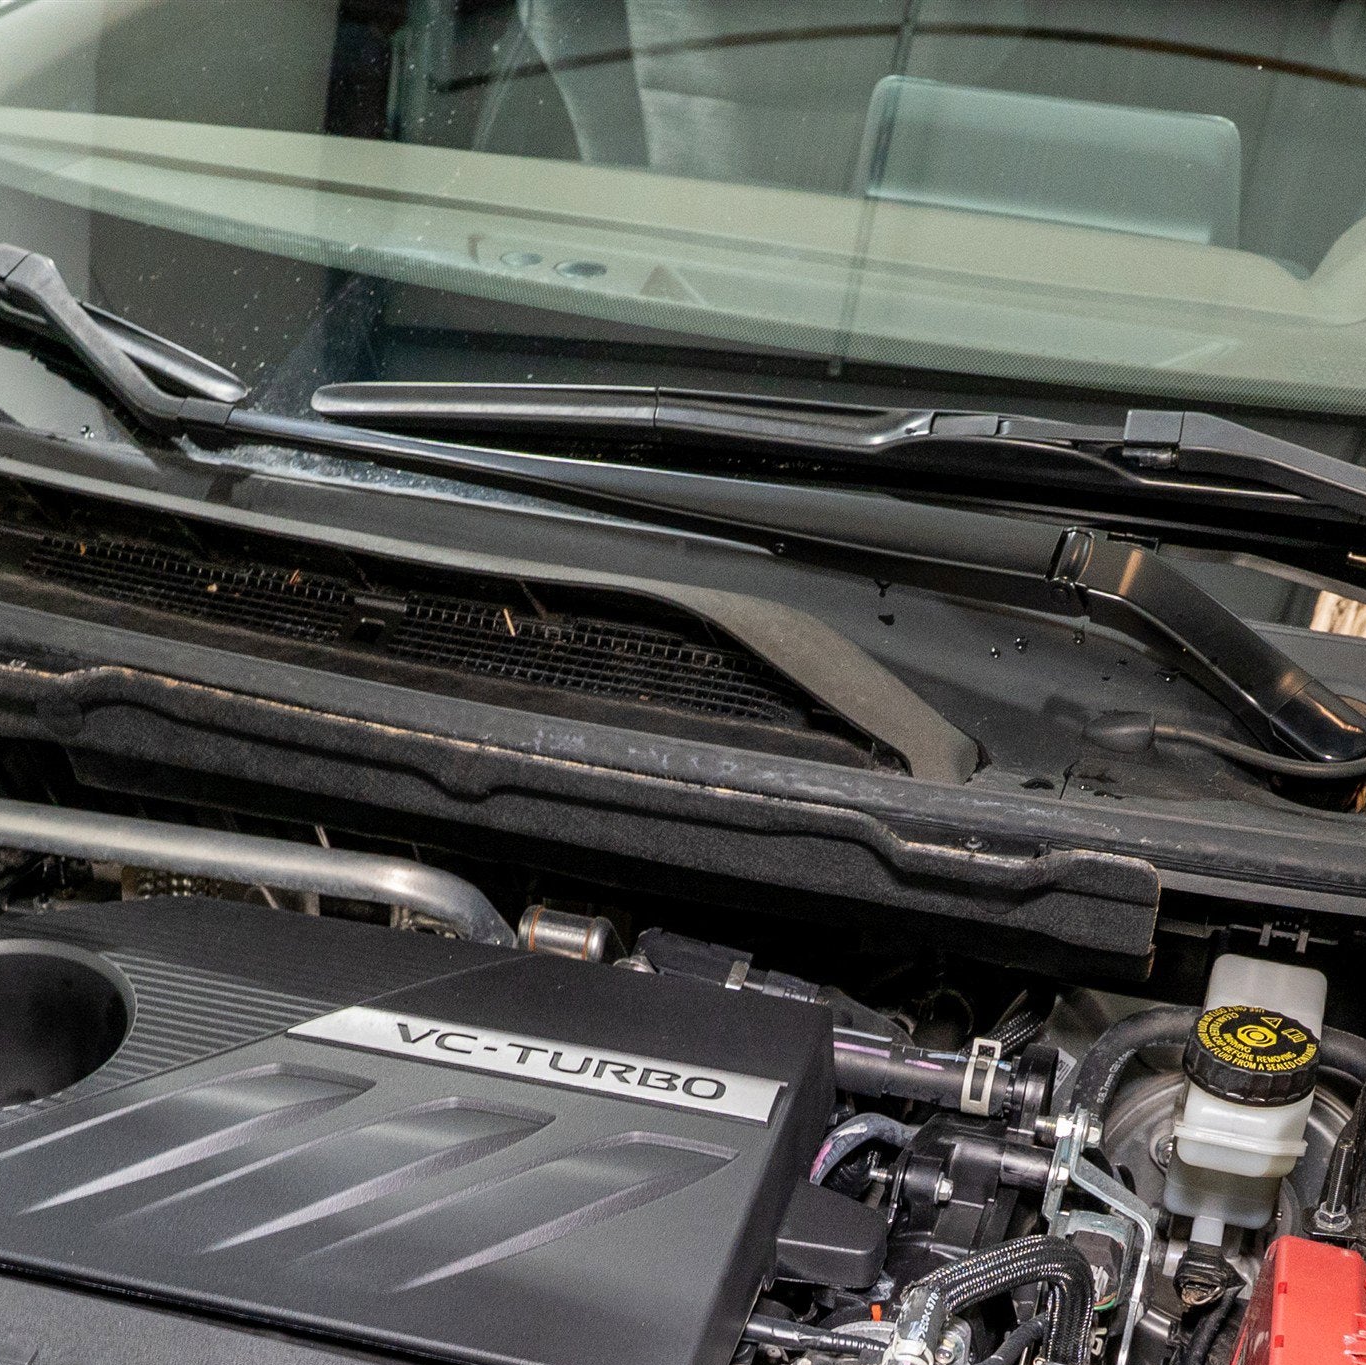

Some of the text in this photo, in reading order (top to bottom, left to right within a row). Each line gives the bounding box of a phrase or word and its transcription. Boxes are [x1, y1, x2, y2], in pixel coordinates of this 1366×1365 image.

[395, 1021, 728, 1101] VC-TURBO
[1211, 1048, 1231, 1061] FLUID
[1232, 1058, 1256, 1069] FROM
[1257, 1063, 1264, 1071] A
[1266, 1060, 1296, 1071] SEALED
[1223, 1045, 1254, 1062] BEFORE
[1256, 1052, 1297, 1063] REMOVING
